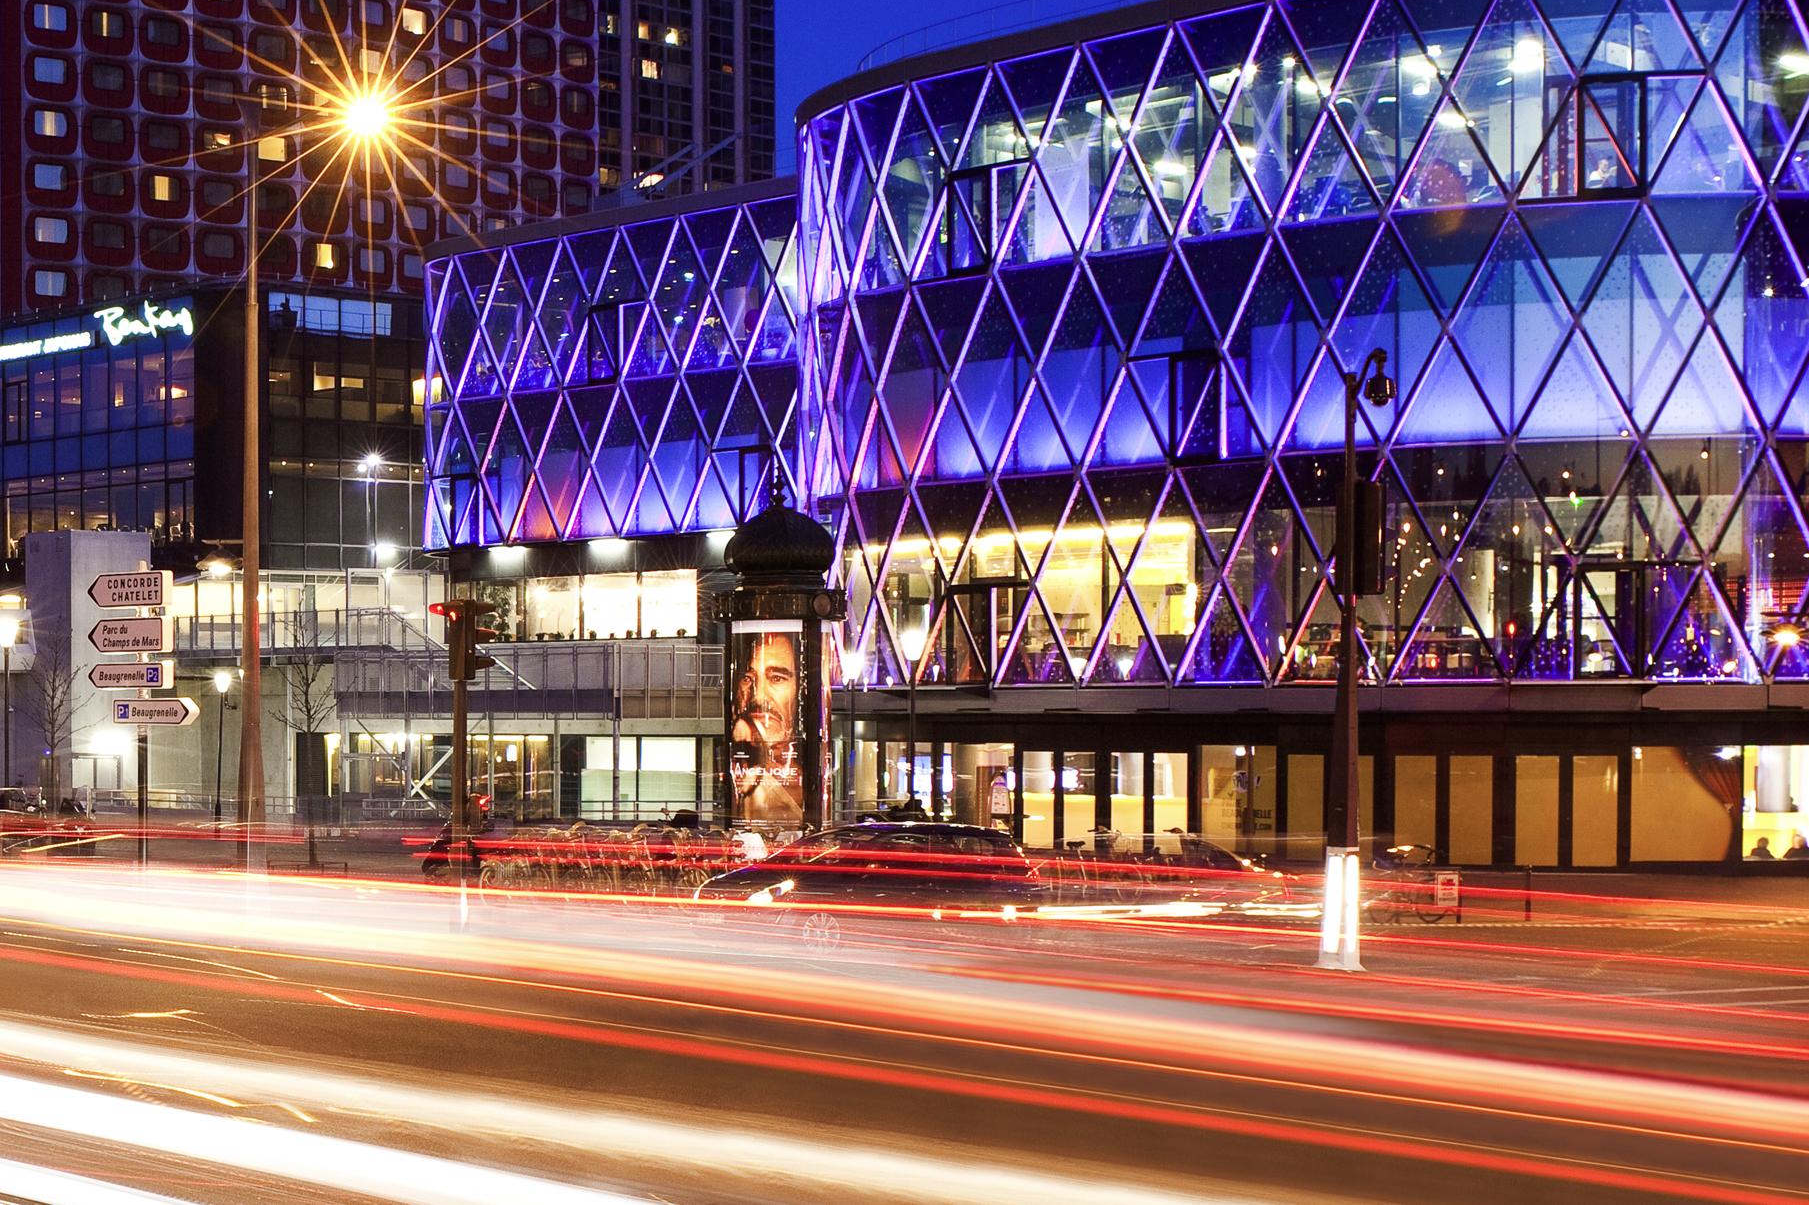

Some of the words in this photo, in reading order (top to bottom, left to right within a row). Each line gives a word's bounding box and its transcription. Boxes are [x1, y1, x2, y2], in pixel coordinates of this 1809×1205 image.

[107, 577, 159, 590] CONCORDE
[111, 590, 159, 602] CHATELET
[102, 625, 118, 635] Parc
[119, 624, 128, 634] du
[102, 638, 130, 649] Champs
[131, 637, 140, 647] de
[141, 636, 159, 647] Mars
[98, 670, 145, 683] Beaugrenelle
[147, 669, 159, 682] P2
[118, 705, 129, 718] P1
[131, 706, 178, 720] Beaugrenelle
